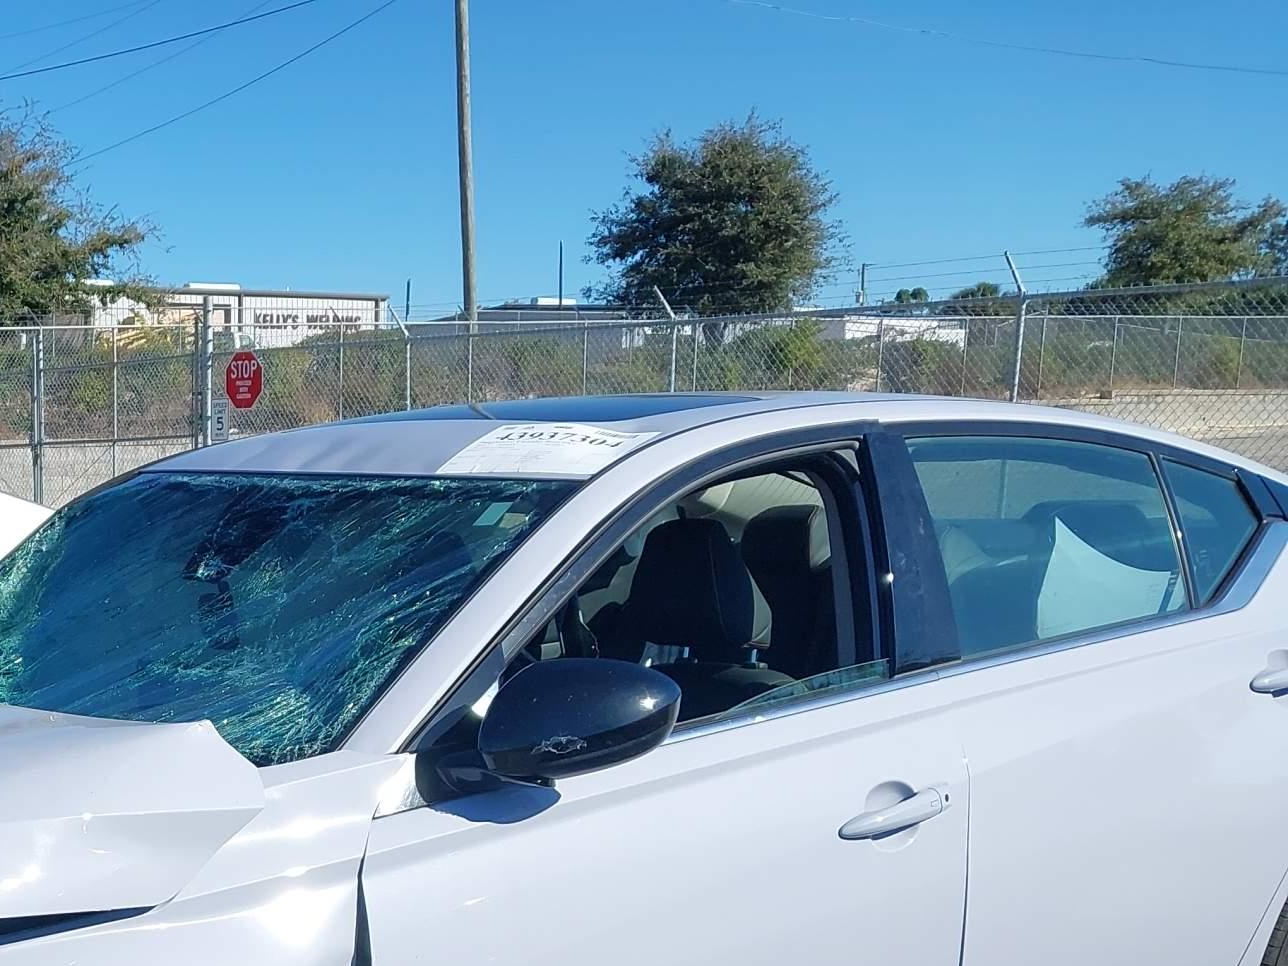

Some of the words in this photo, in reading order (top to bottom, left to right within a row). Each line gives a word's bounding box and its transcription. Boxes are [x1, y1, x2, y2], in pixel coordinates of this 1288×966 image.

[254, 312, 300, 330] KELLY'S
[230, 359, 258, 379] STOP
[216, 416, 224, 431] 5
[495, 430, 625, 449] 43937304
